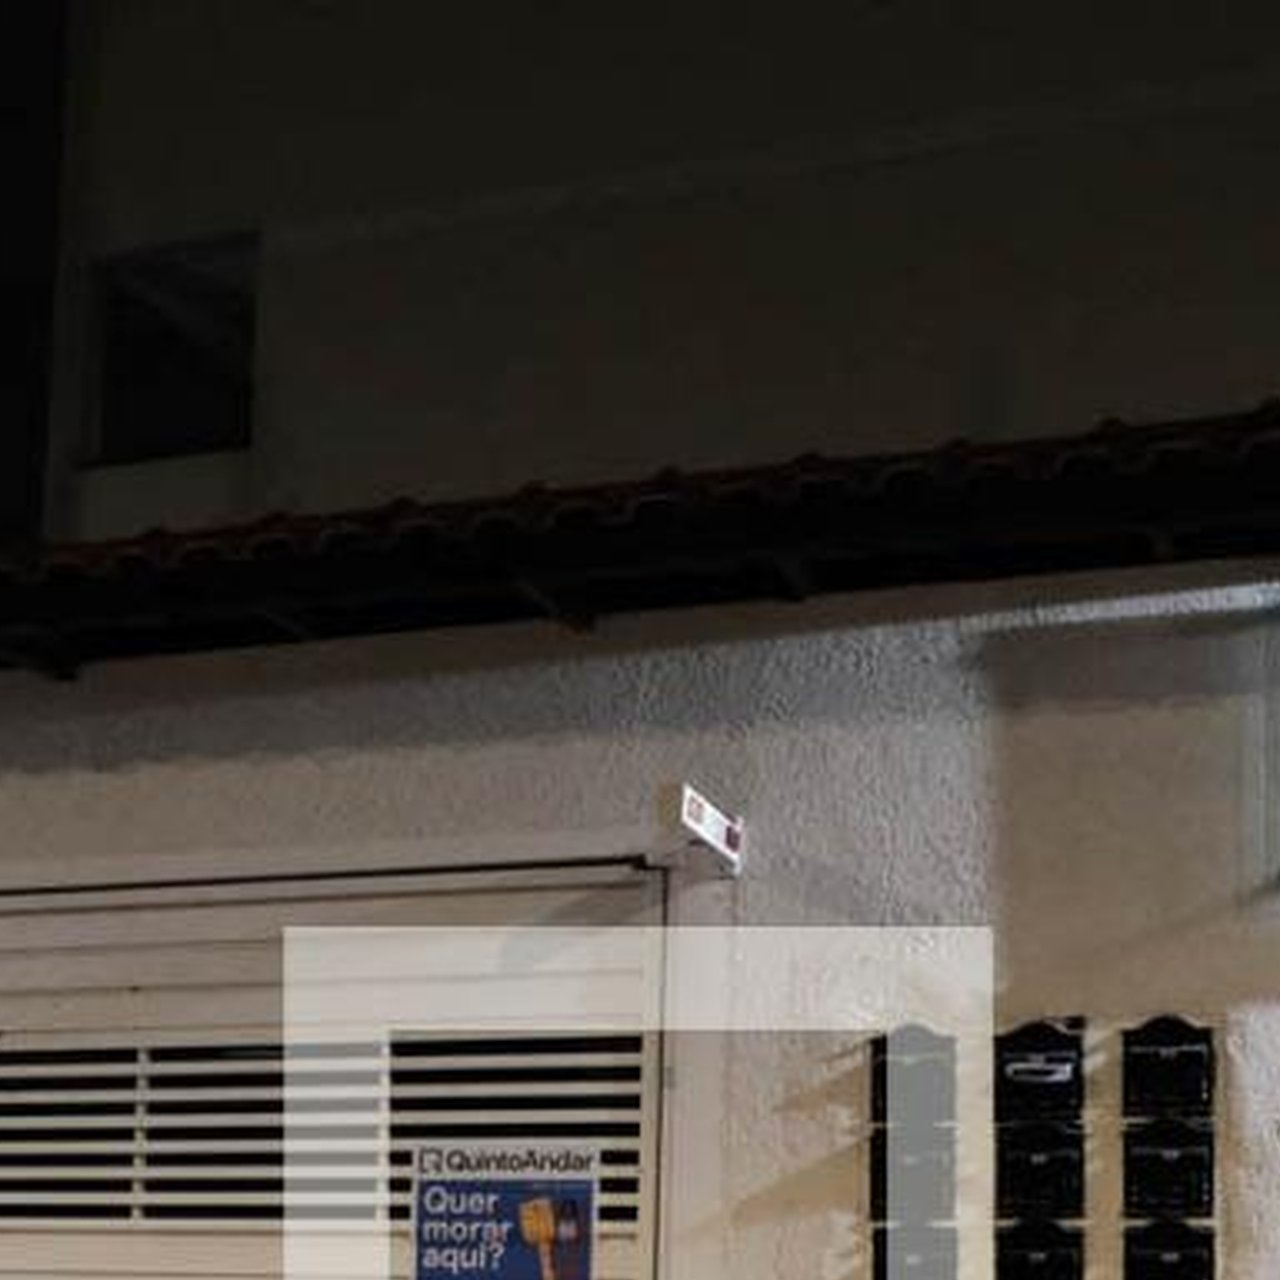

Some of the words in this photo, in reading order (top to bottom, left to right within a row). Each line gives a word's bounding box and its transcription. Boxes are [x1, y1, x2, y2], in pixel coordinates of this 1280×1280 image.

[446, 1149, 594, 1172] QuintoAndar
[423, 1186, 500, 1215] Quer
[423, 1220, 513, 1242] morar
[422, 1243, 505, 1275] aqui?
